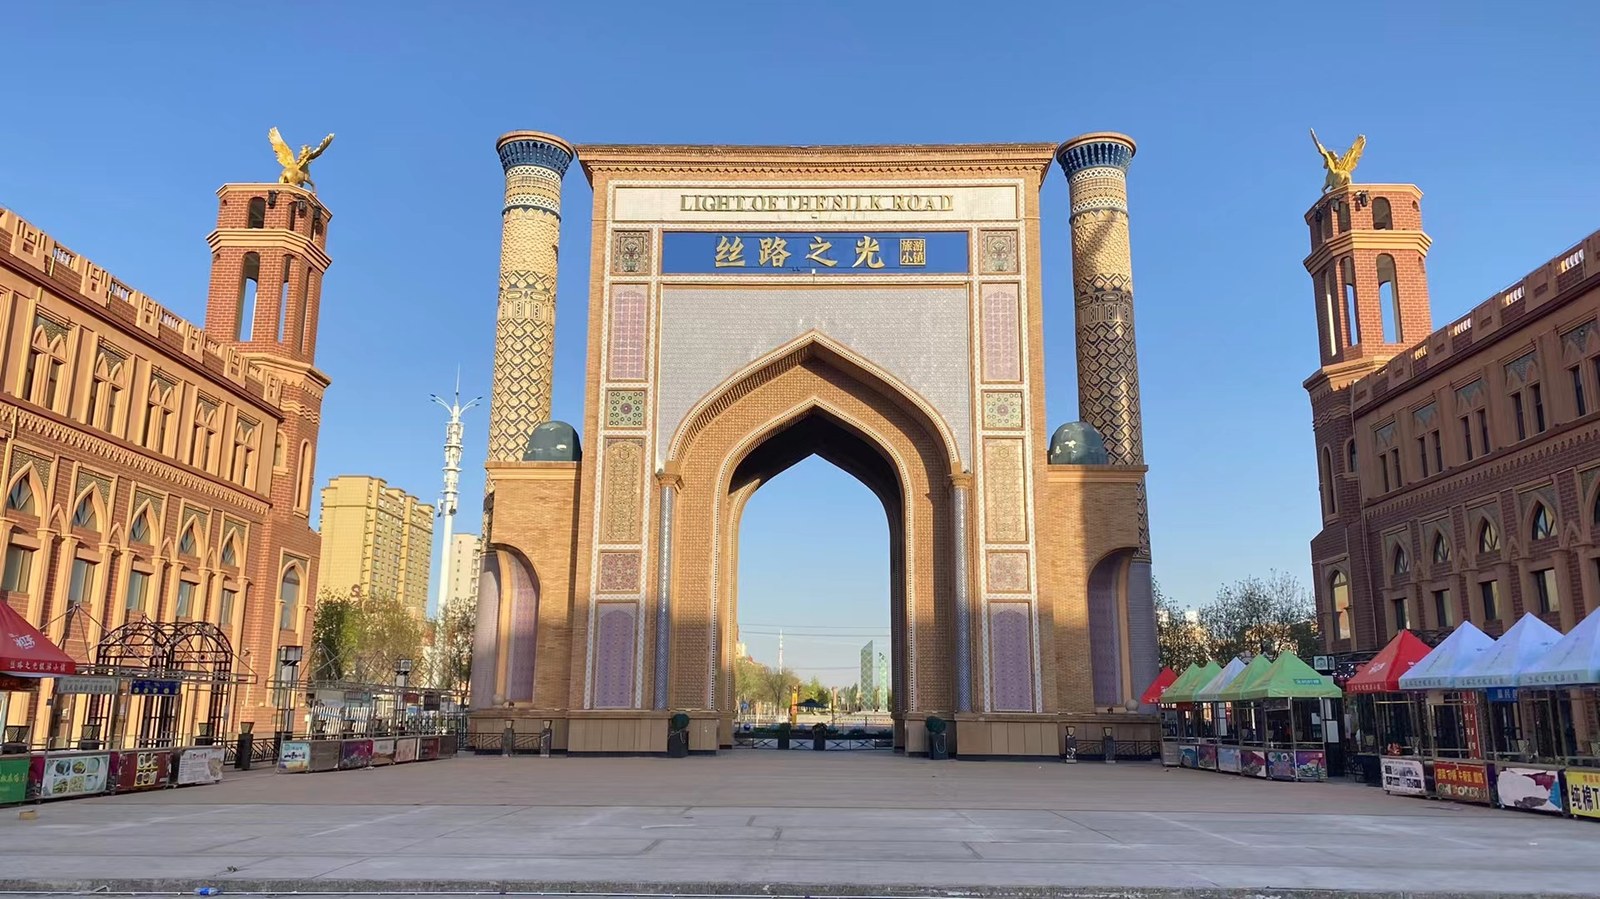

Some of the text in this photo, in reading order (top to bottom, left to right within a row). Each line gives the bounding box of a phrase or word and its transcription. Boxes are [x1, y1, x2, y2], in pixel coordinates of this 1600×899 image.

[680, 194, 954, 212] LIGHT OF THE SILK ROAD
[714, 235, 885, 269] 丝路之光
